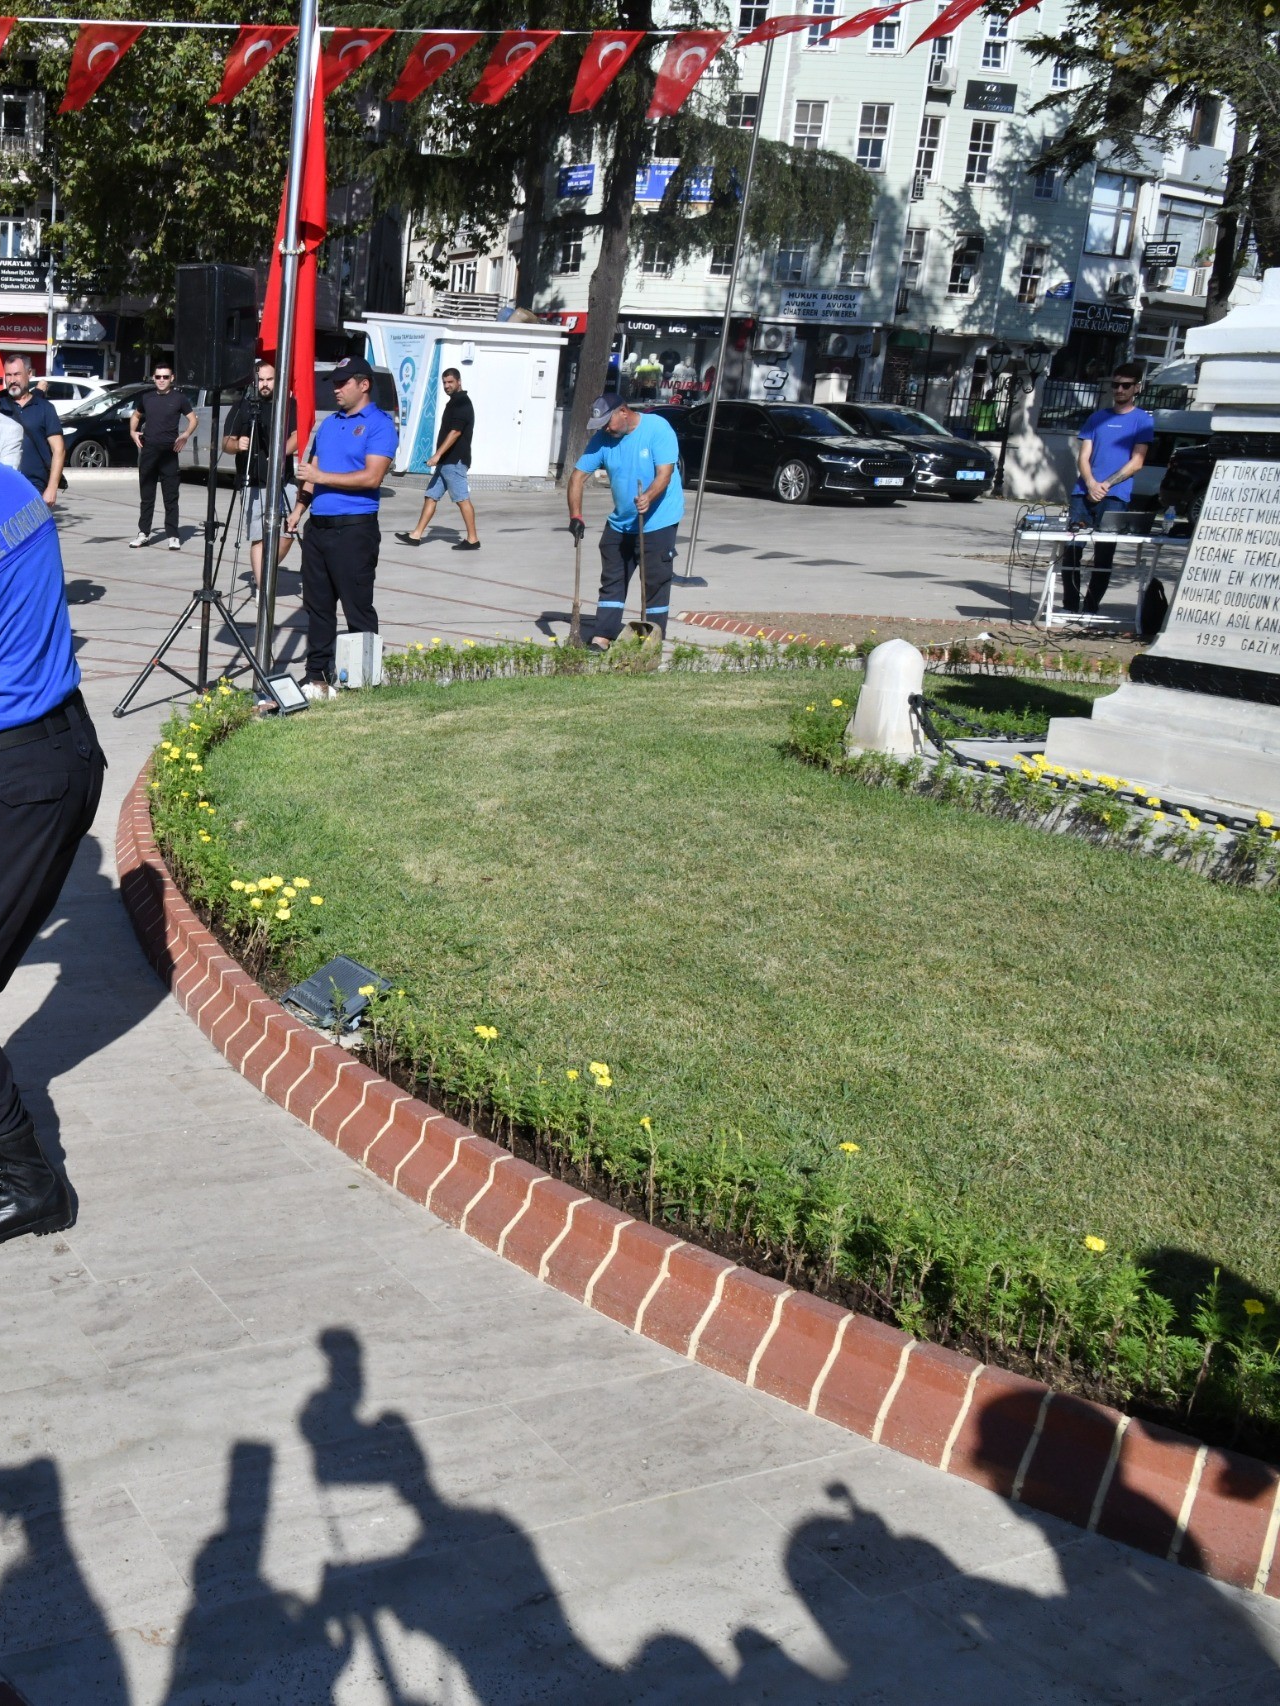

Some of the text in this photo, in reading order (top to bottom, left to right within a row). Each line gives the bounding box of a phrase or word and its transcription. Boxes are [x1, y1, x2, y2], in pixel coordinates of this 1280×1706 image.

[788, 291, 818, 300] HUKUK
[1214, 465, 1229, 480] EY
[1256, 508, 1280, 525] MUH
[1244, 549, 1280, 568] TEMEL
[1228, 570, 1244, 585] EN
[1250, 572, 1280, 590] KIYM
[1254, 616, 1280, 634] KAN
[1196, 632, 1226, 648] 1929
[1240, 636, 1269, 654] GAZİ
